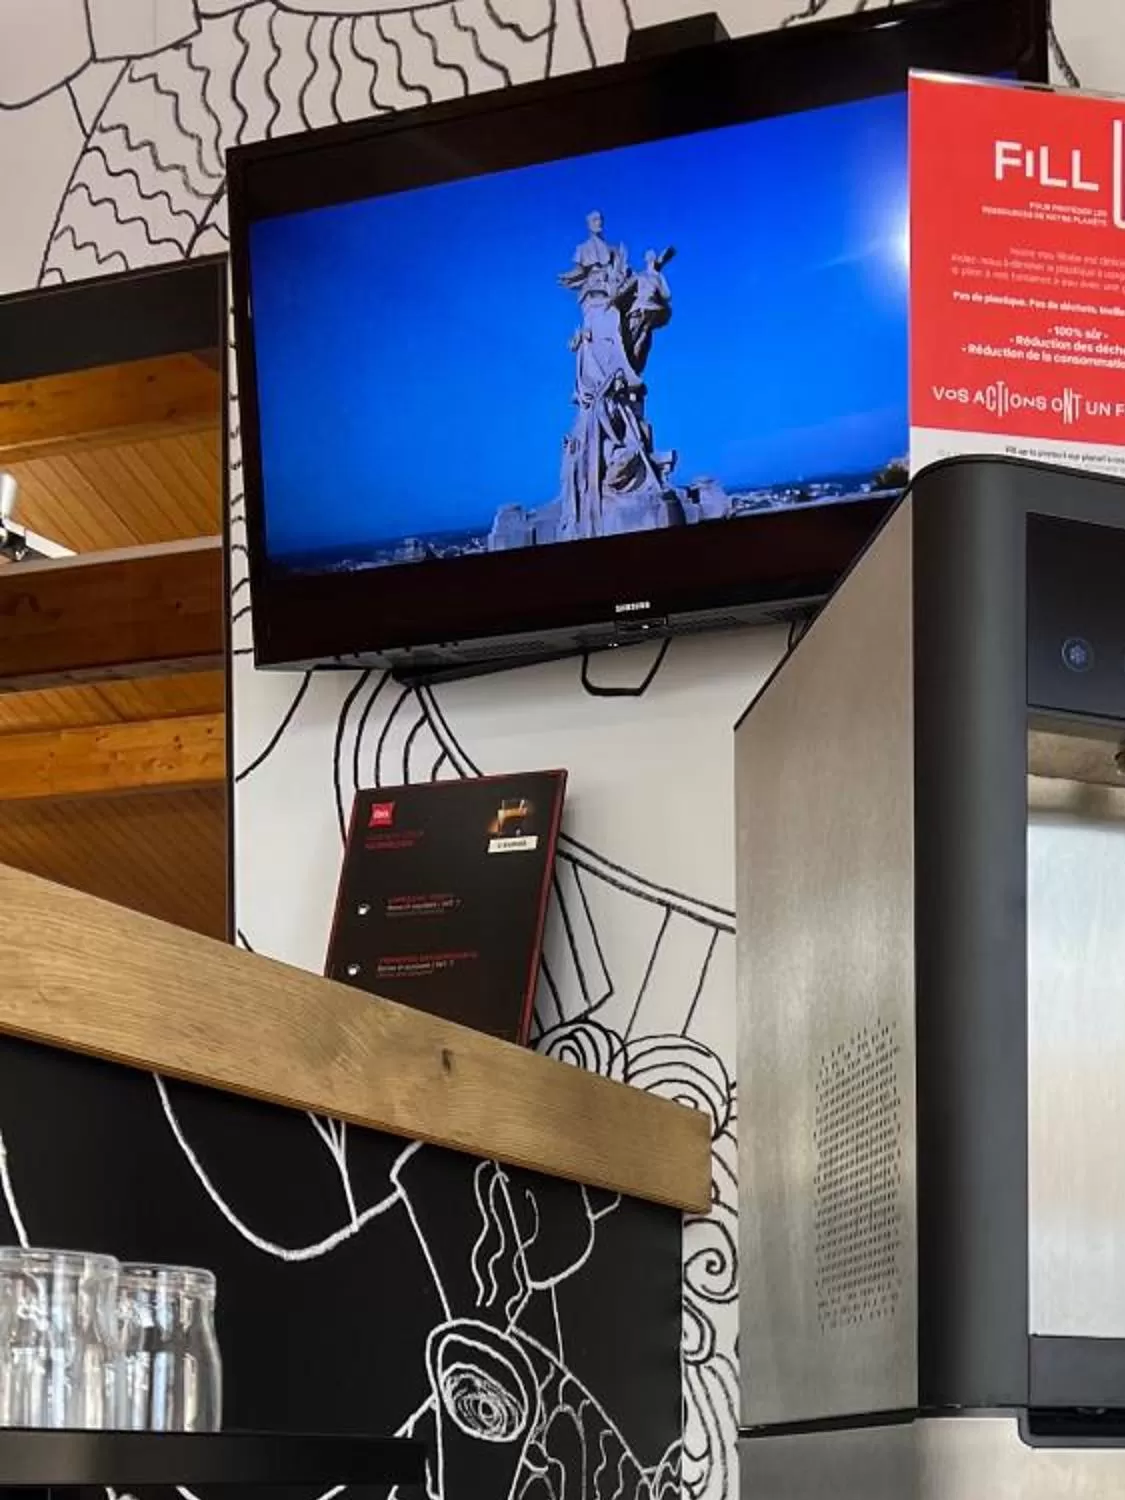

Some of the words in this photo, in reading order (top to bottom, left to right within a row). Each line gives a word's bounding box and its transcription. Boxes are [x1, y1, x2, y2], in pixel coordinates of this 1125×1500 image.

[994, 140, 1099, 192] FILL
[1054, 325, 1083, 339] 100%
[967, 343, 1025, 360] Réduction
[1026, 348, 1041, 361] de
[1041, 350, 1053, 362] la
[1015, 335, 1072, 351] Réduction
[1073, 340, 1095, 354] des
[972, 380, 1047, 417] ACTIONS
[1051, 387, 1083, 424] ONT
[1085, 400, 1111, 417] UN
